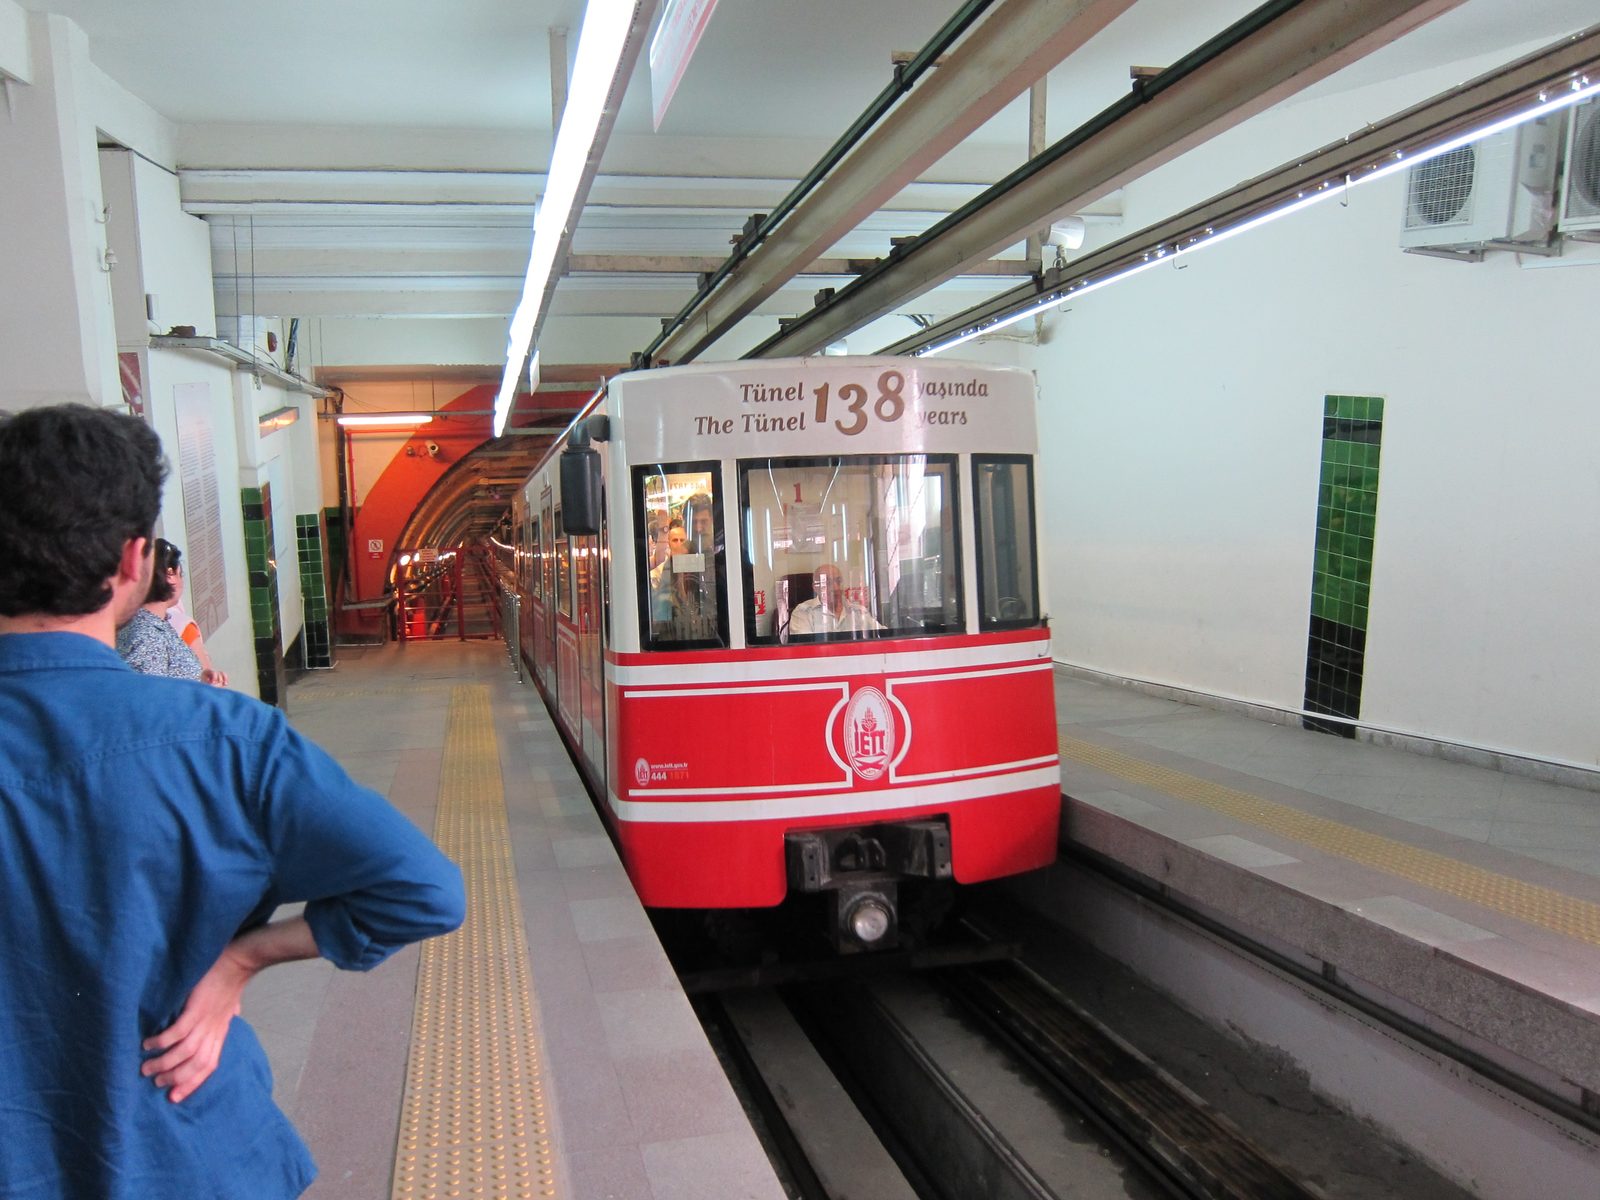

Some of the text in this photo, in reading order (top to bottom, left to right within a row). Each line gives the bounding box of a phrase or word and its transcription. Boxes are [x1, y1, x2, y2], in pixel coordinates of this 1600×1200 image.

[740, 370, 989, 436] Tünel 138 yaşında
[694, 411, 806, 436] The Tünel
[651, 771, 668, 781] 444
